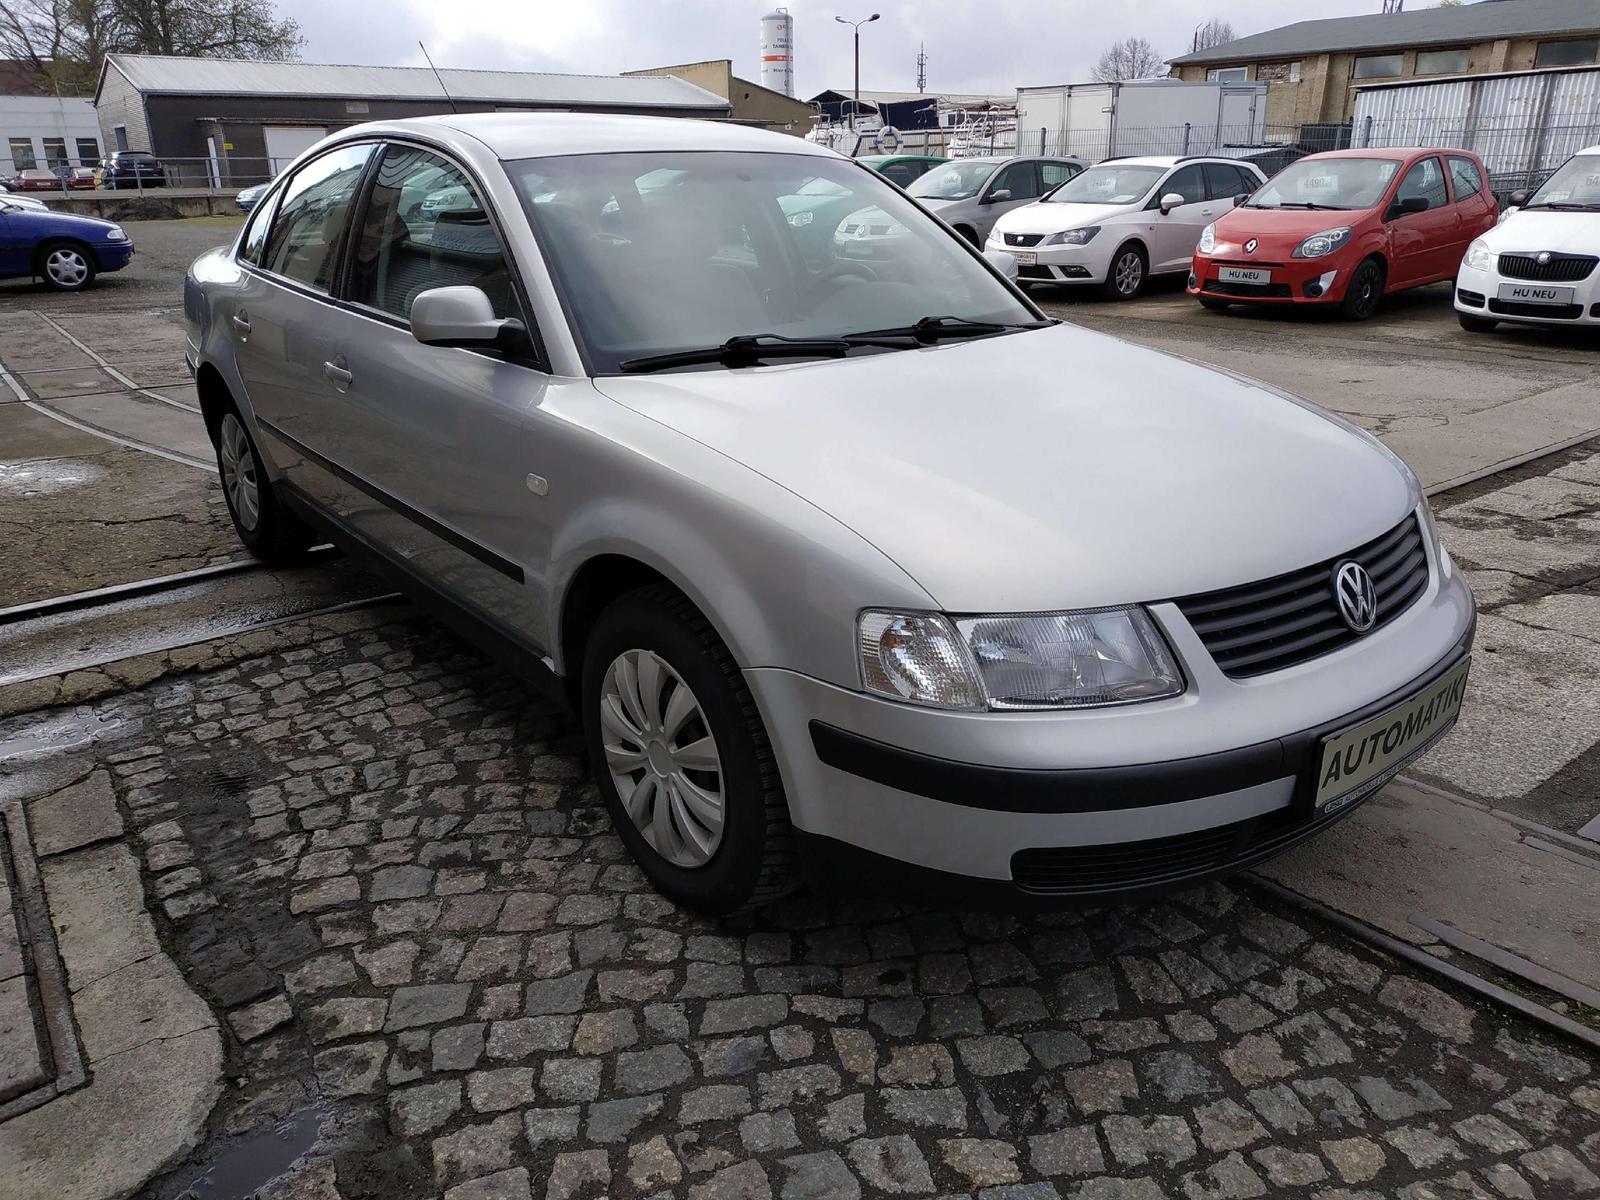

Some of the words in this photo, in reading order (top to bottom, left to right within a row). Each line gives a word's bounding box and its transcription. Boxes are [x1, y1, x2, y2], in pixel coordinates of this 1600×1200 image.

[1228, 270, 1240, 278] HU
[1241, 271, 1259, 280] NEU
[1512, 288, 1530, 297] HU
[1531, 290, 1557, 299] NEU
[1321, 672, 1467, 789] AUTOMATIK
